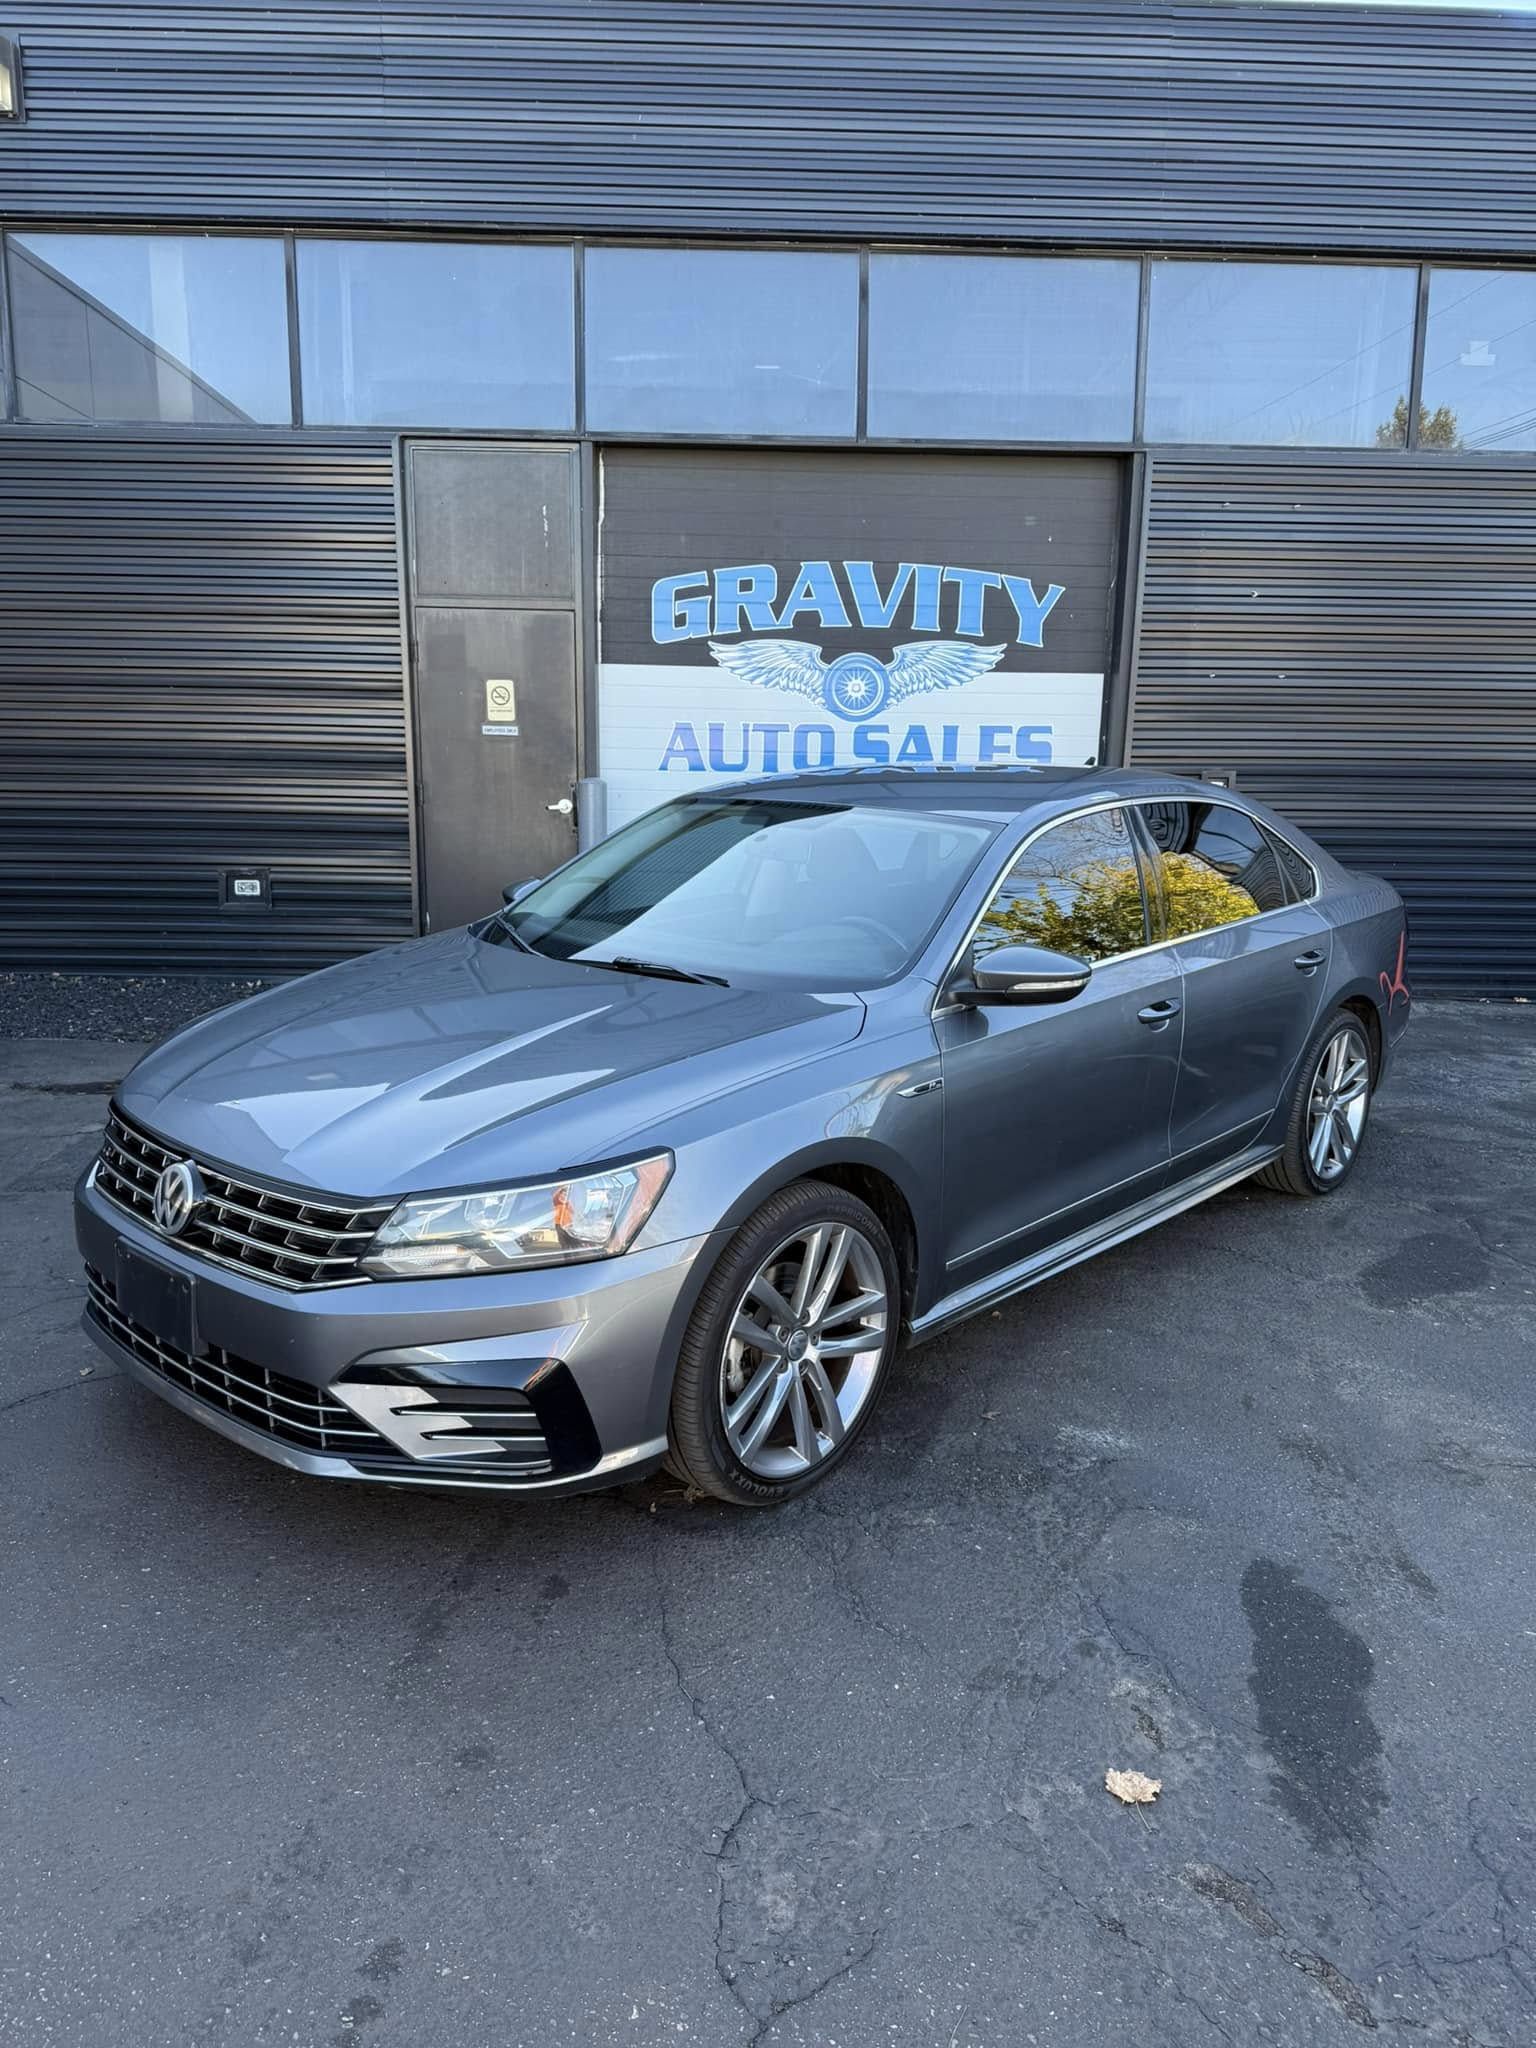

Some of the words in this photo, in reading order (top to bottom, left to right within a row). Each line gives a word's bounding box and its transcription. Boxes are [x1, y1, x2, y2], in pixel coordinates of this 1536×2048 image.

[651, 561, 1066, 648] GRAVITY
[658, 721, 836, 773] AUTO
[852, 723, 1054, 764] SALES
